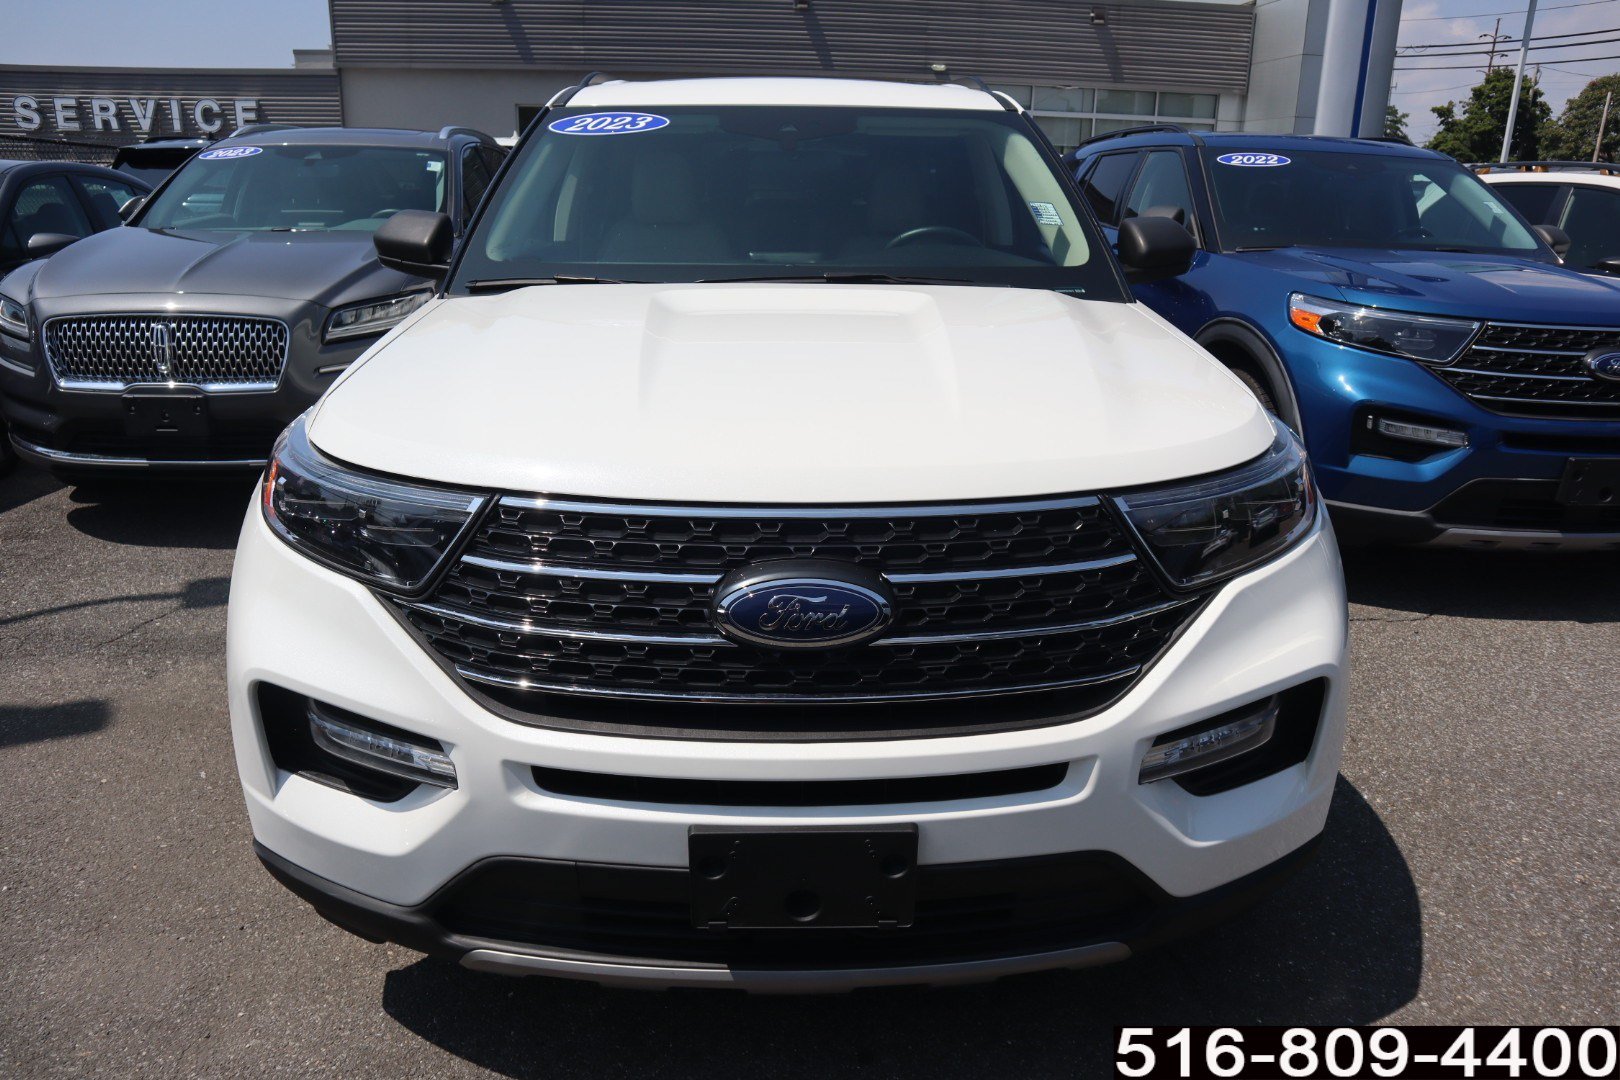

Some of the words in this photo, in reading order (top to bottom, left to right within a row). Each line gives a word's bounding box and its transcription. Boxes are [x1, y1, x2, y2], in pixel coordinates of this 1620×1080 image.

[13, 95, 259, 133] SERVICE
[563, 115, 653, 132] 2023
[206, 147, 256, 158] 2023
[1230, 154, 1279, 166] 2022
[759, 594, 851, 631] Ford
